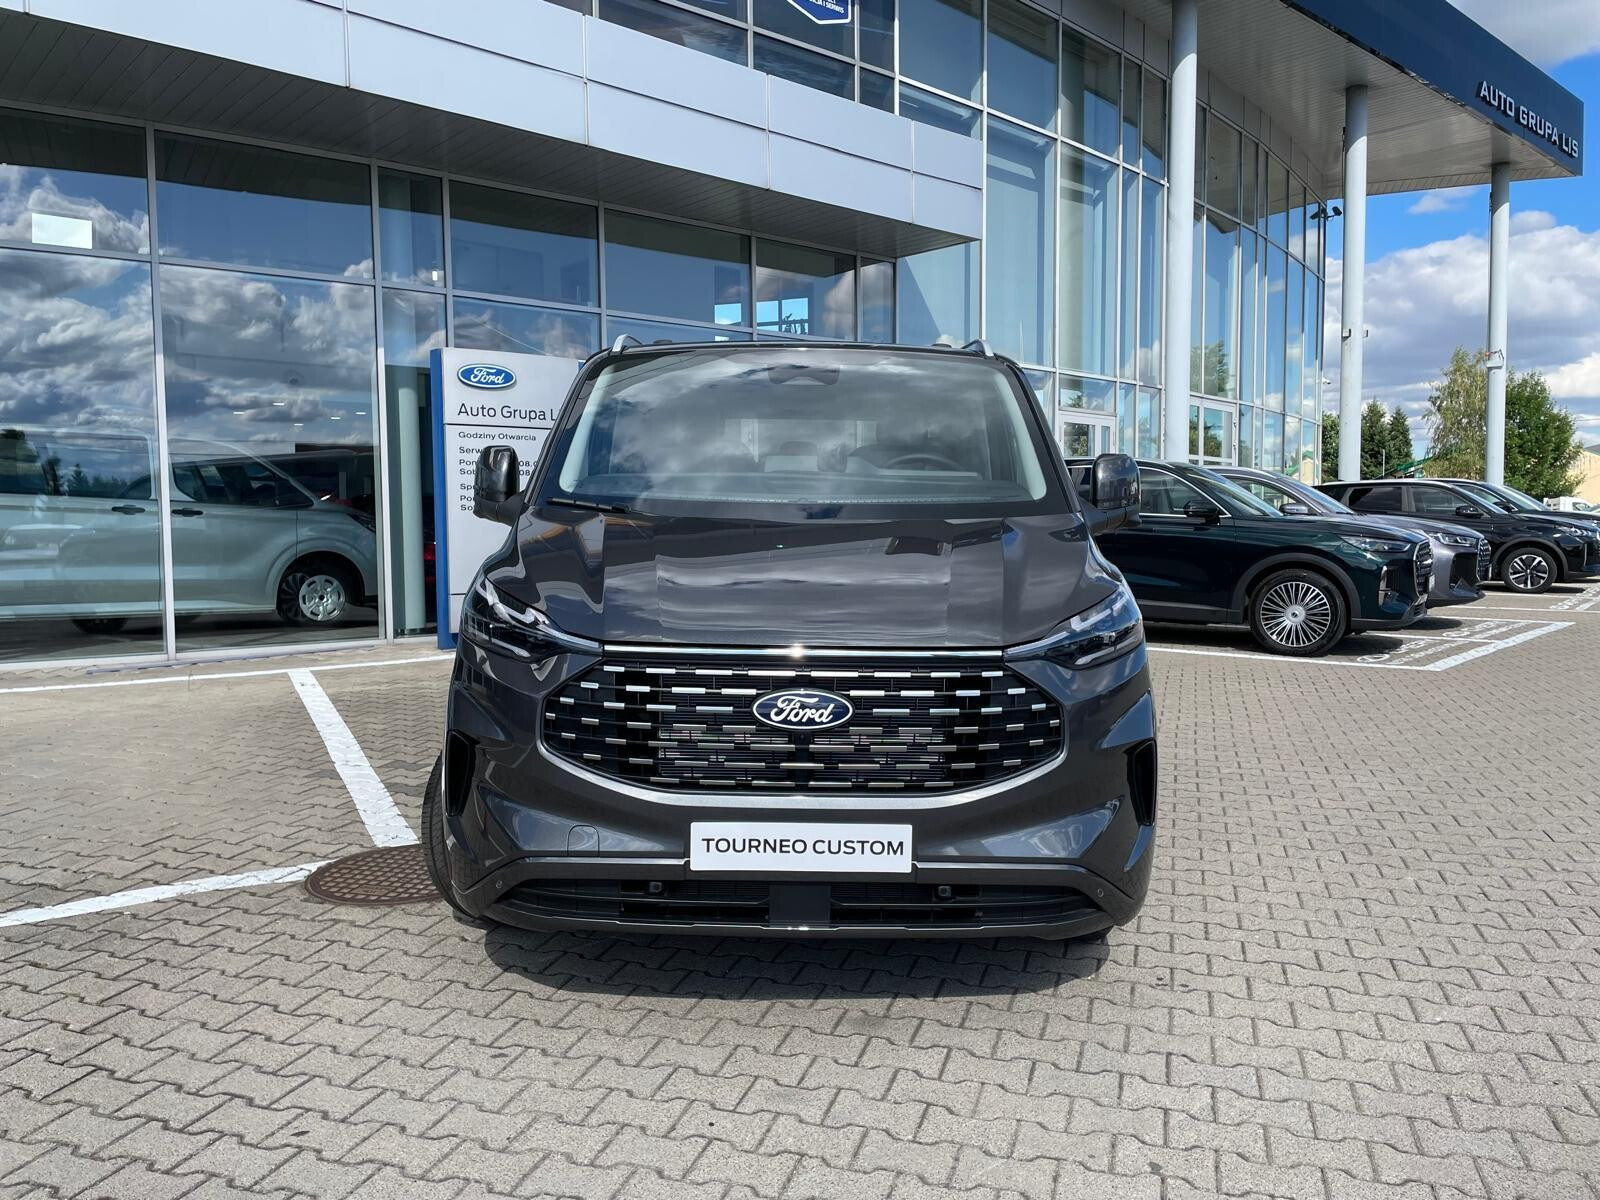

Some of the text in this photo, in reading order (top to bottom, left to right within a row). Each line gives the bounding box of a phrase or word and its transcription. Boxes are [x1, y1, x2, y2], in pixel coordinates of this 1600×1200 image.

[1480, 81, 1579, 158] AUTO GRUPA LIS
[470, 367, 505, 384] Ford
[457, 403, 497, 418] Auto
[500, 405, 546, 422] Grupa
[458, 431, 537, 441] Godziny Otwarcia
[770, 695, 835, 723] Ford
[701, 838, 905, 856] TOURNEO CUSTOM
